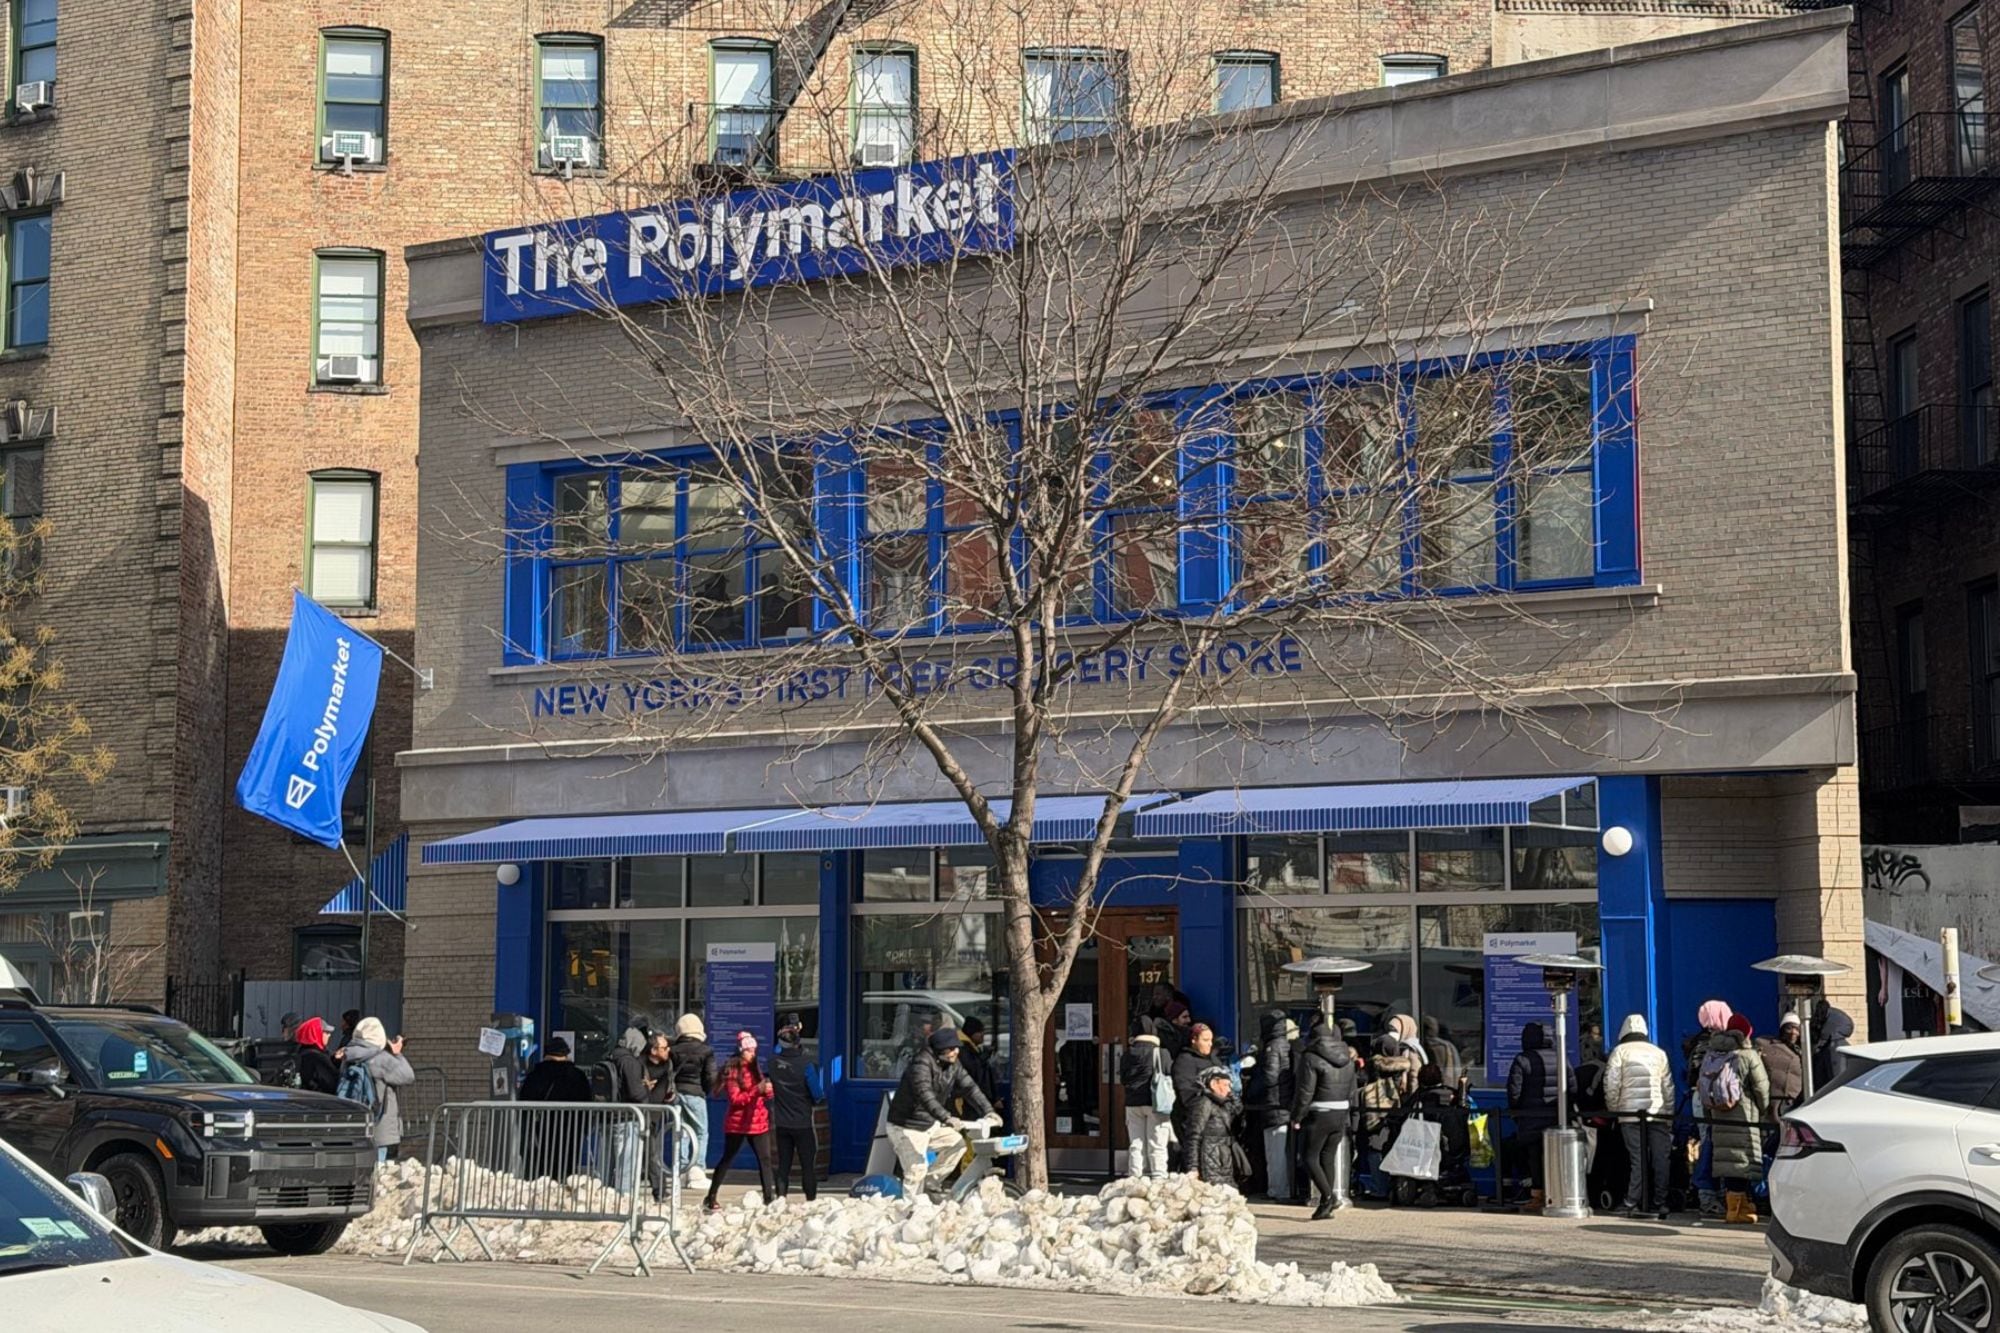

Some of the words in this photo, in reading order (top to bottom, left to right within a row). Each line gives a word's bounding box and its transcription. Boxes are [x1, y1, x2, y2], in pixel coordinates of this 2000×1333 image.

[494, 231, 607, 296] The
[629, 162, 1000, 281] Polymarket
[302, 637, 351, 772] Polymarket
[534, 683, 611, 718] NEW
[1168, 637, 1302, 678] STORE
[1139, 971, 1162, 984] 137
[1500, 939, 1537, 948] Polymarket
